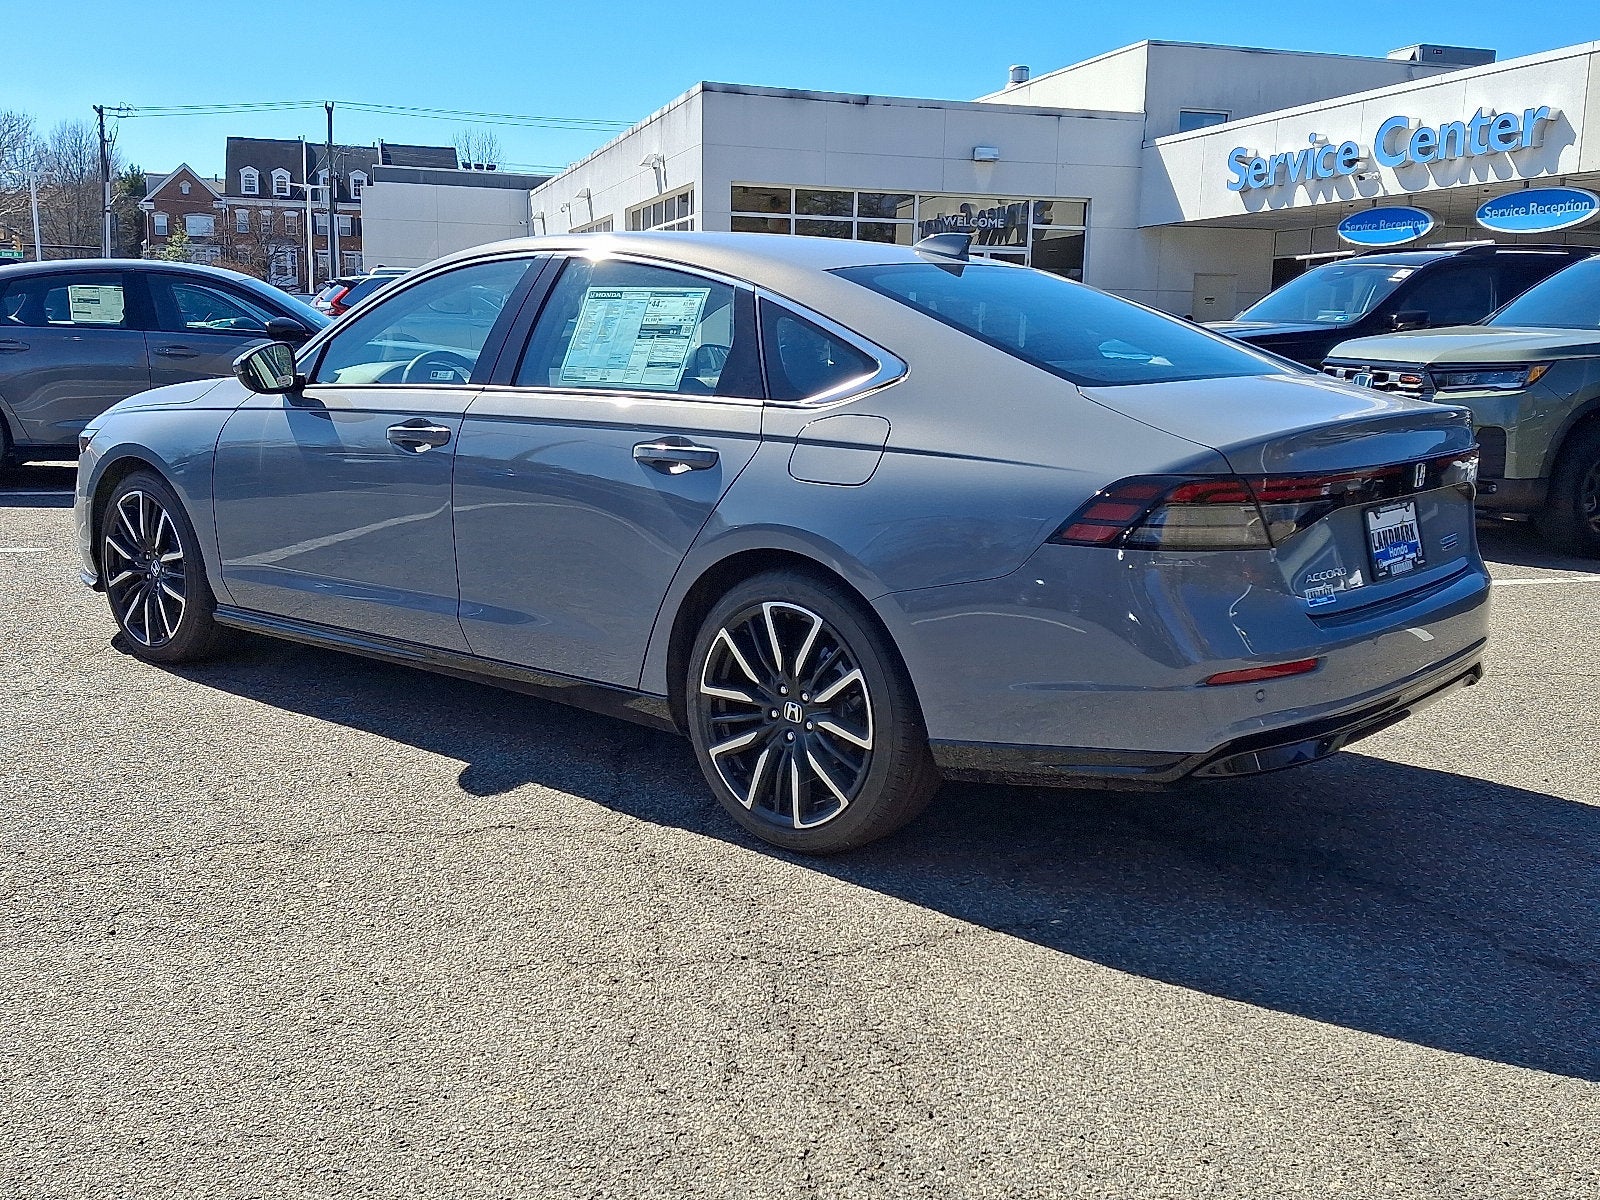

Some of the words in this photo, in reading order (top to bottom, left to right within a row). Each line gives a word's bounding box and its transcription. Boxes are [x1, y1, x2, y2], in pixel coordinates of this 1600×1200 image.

[1226, 132, 1360, 191] Service
[1374, 105, 1551, 168] Center
[1484, 204, 1526, 219] Service
[1529, 198, 1590, 217] Reception
[943, 216, 1004, 228] WELCOME
[1345, 220, 1377, 231] Service
[1380, 218, 1425, 232] Reception
[595, 291, 622, 299] HONDA
[1371, 522, 1417, 552] LANDMARK
[1388, 544, 1409, 558] Honda
[1305, 566, 1347, 583] ACCORD
